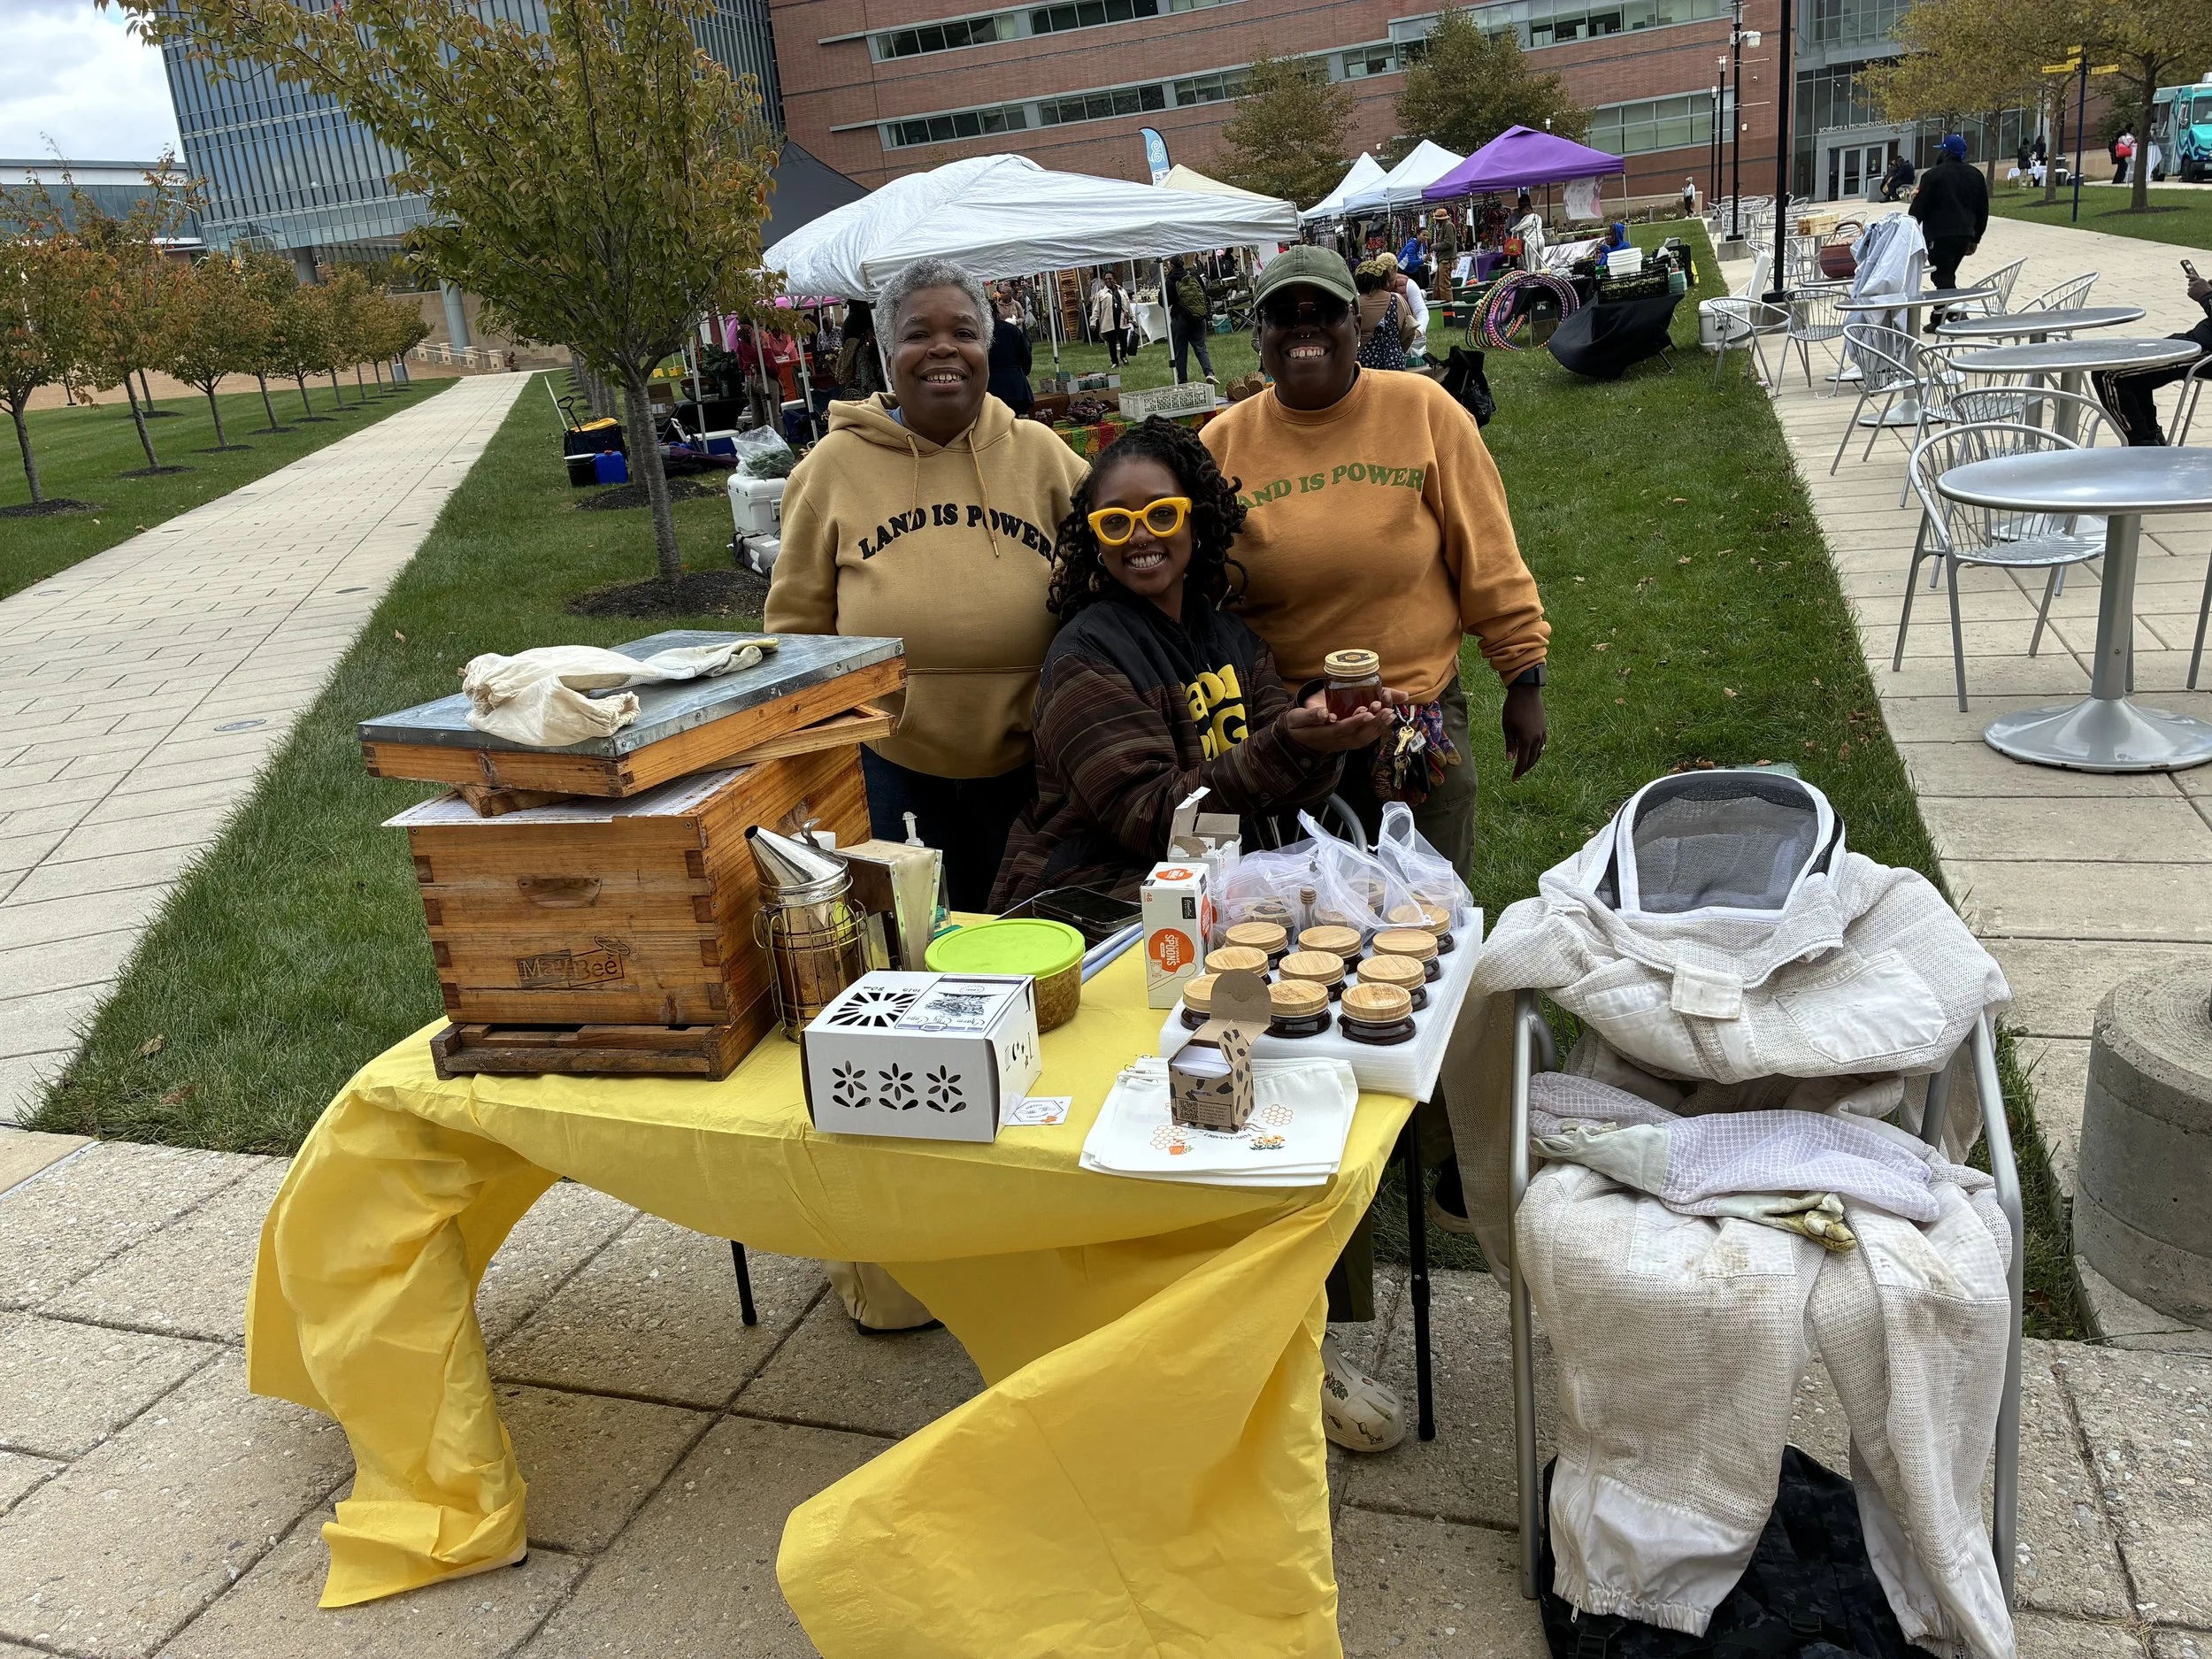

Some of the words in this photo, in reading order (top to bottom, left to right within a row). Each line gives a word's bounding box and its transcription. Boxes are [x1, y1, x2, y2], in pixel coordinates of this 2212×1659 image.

[1237, 479, 1292, 509] AND
[1299, 473, 1325, 494] IS
[1332, 462, 1425, 492] POWER
[858, 508, 926, 560] LAND
[931, 503, 958, 526] IS
[966, 505, 1053, 563] POWER
[1147, 892, 1153, 902] 48
[1164, 933, 1177, 966] SPOONS
